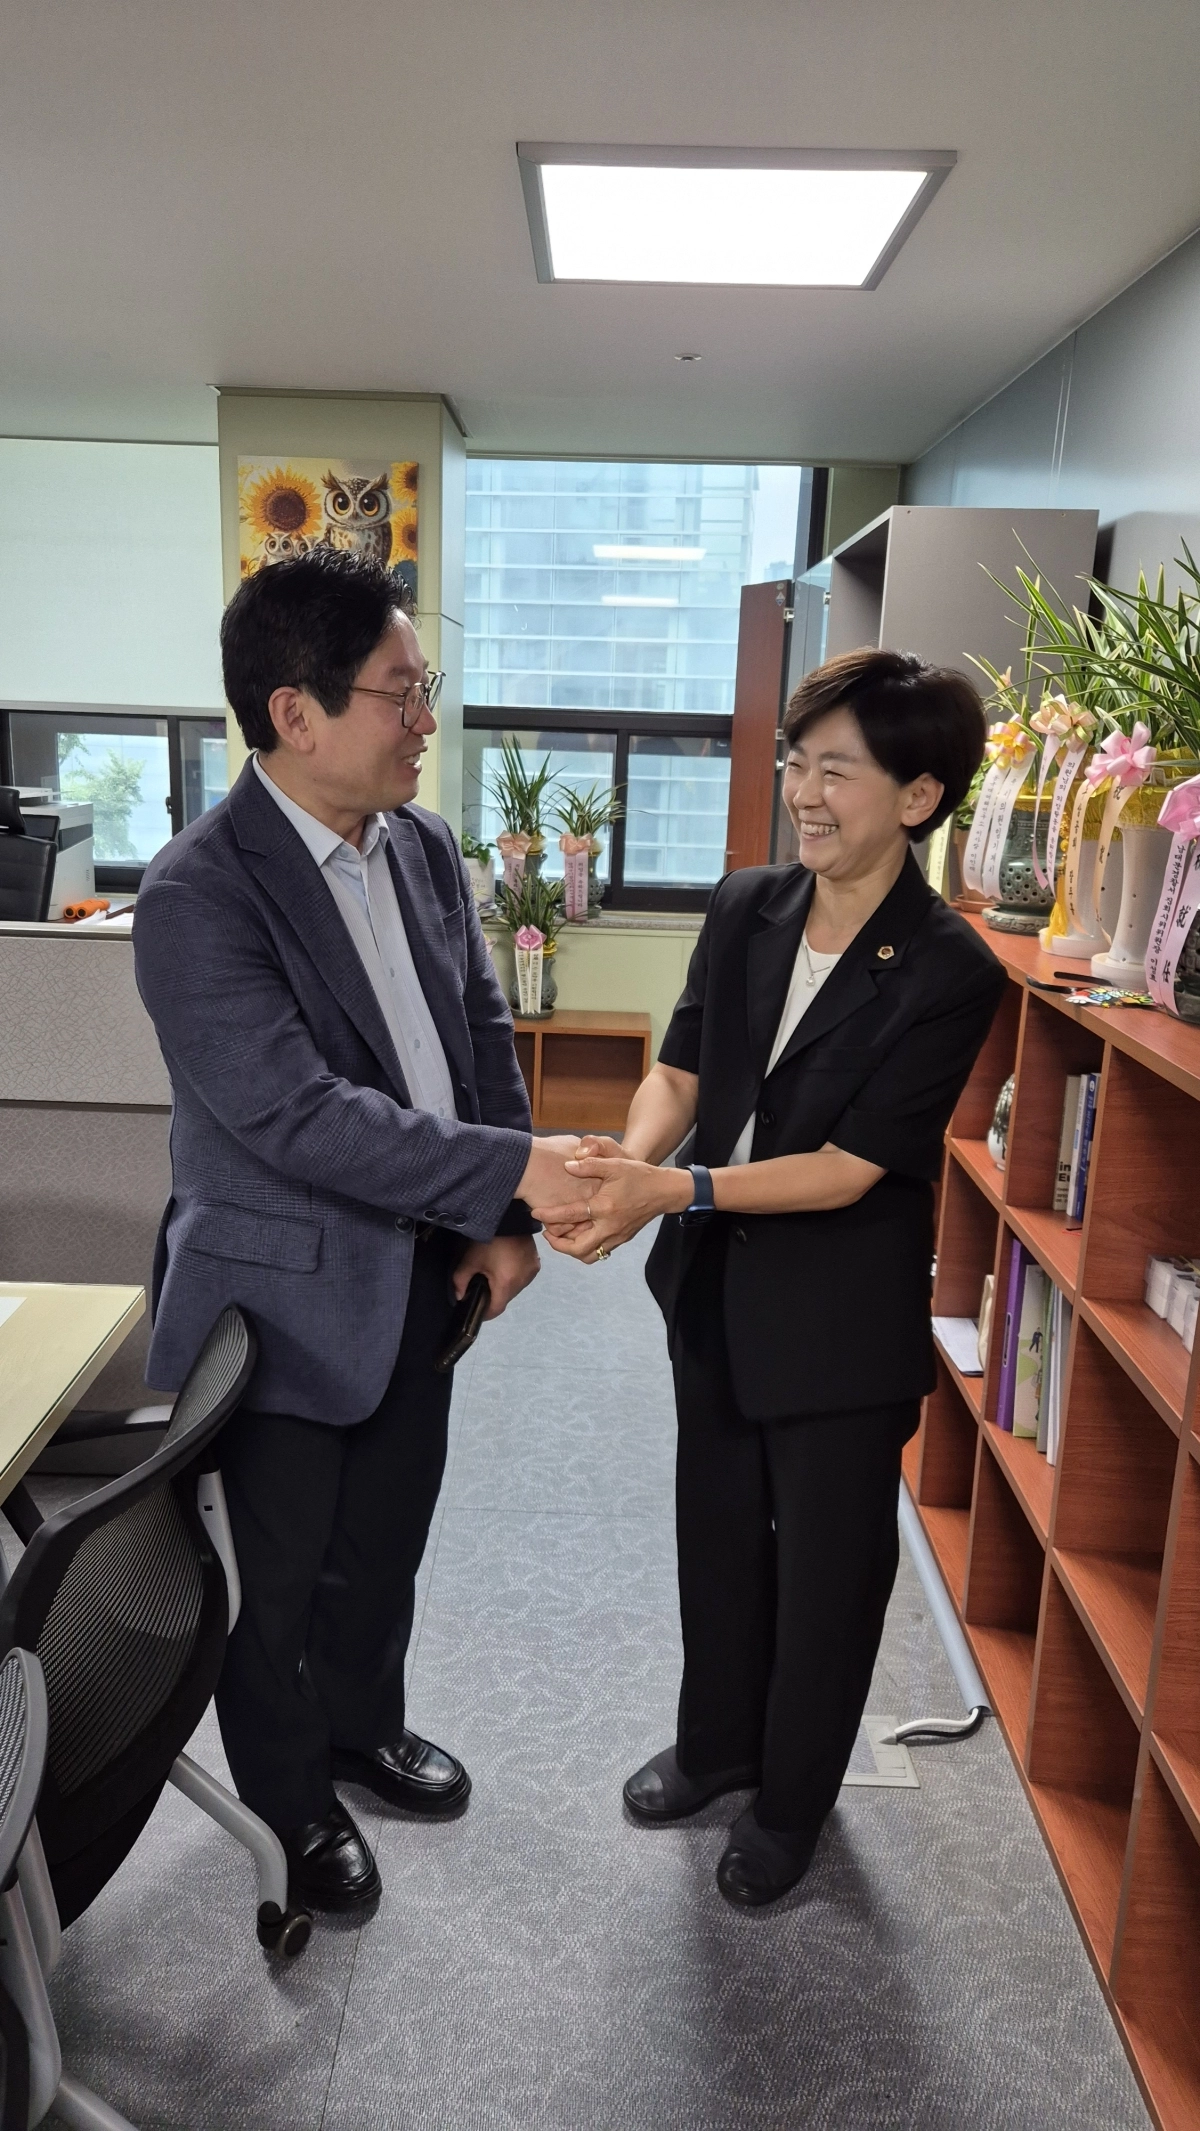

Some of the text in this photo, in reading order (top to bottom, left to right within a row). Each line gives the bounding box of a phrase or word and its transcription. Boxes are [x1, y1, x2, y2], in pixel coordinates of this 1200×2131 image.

[1059, 762, 1075, 791] 의원님의
[1052, 796, 1063, 833] 의정활동을
[974, 830, 983, 850] 이사장
[1167, 845, 1186, 895] 남대문경찰서
